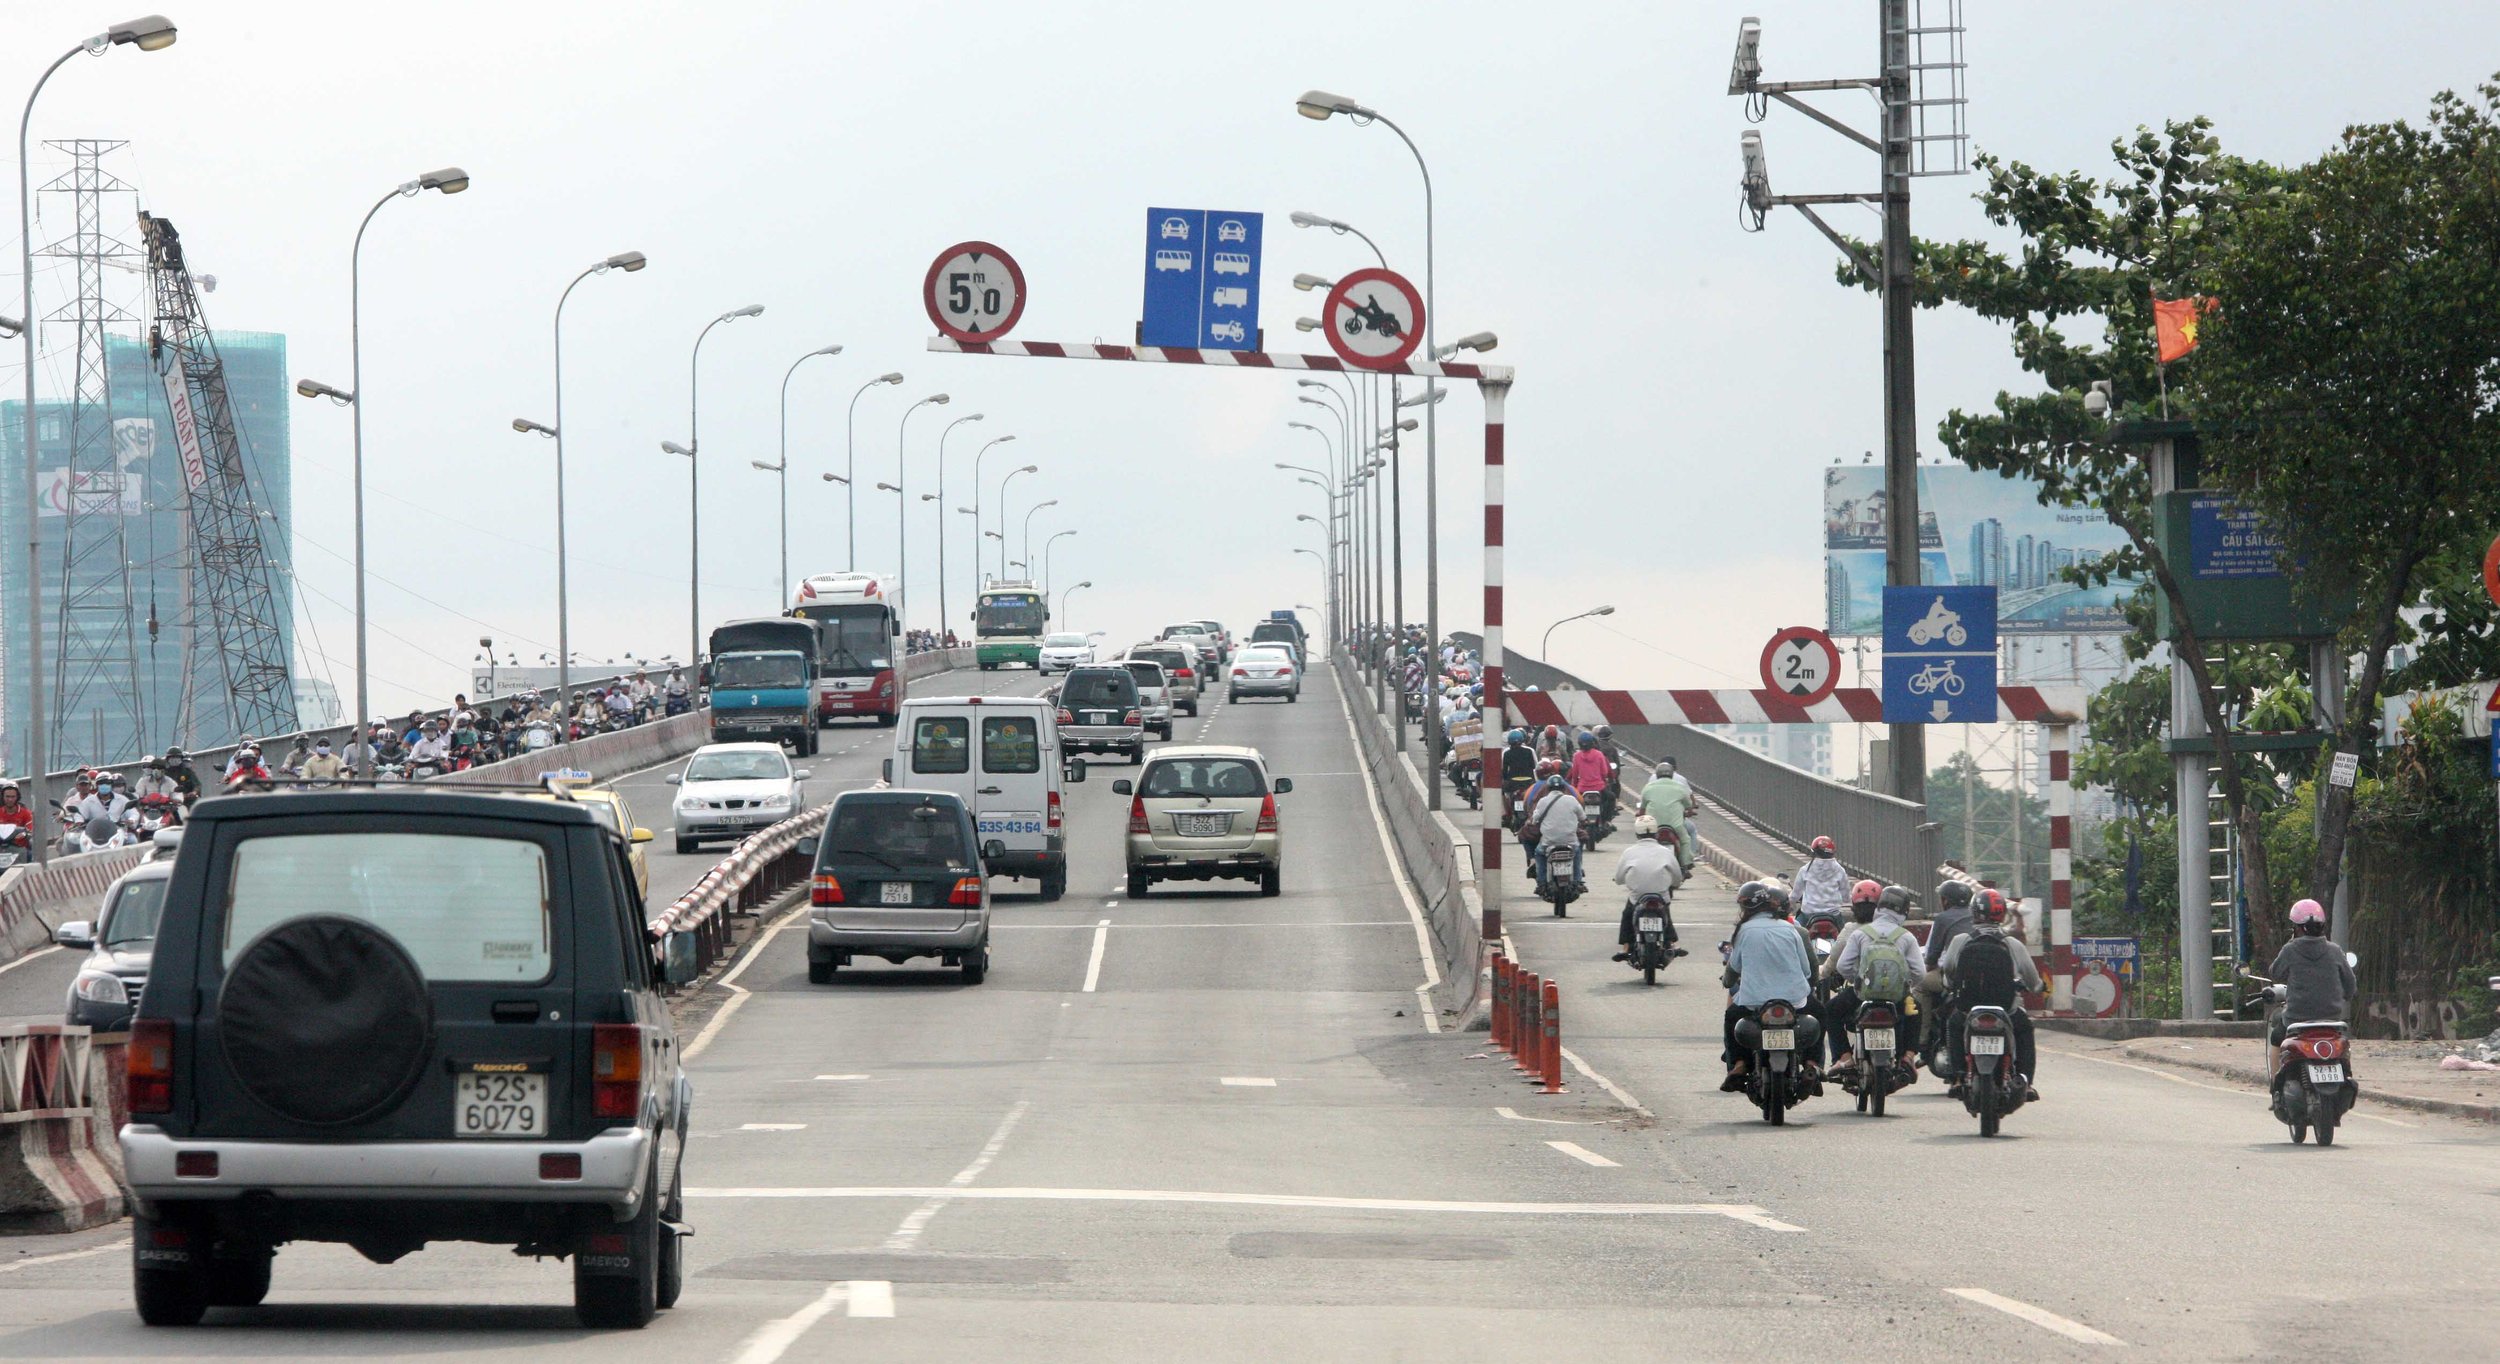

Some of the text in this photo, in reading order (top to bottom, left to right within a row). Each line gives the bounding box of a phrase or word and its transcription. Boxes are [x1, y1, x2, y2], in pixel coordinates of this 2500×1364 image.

[174, 393, 203, 487] TUẤN LỘC
[1786, 654, 1815, 680] 2m
[751, 694, 758, 706] 3
[1193, 824, 1213, 832] 5090
[885, 892, 909, 902] 7518
[475, 1074, 526, 1102] 52S
[466, 1104, 534, 1131] 6079
[582, 1255, 630, 1268] DAEWOO
